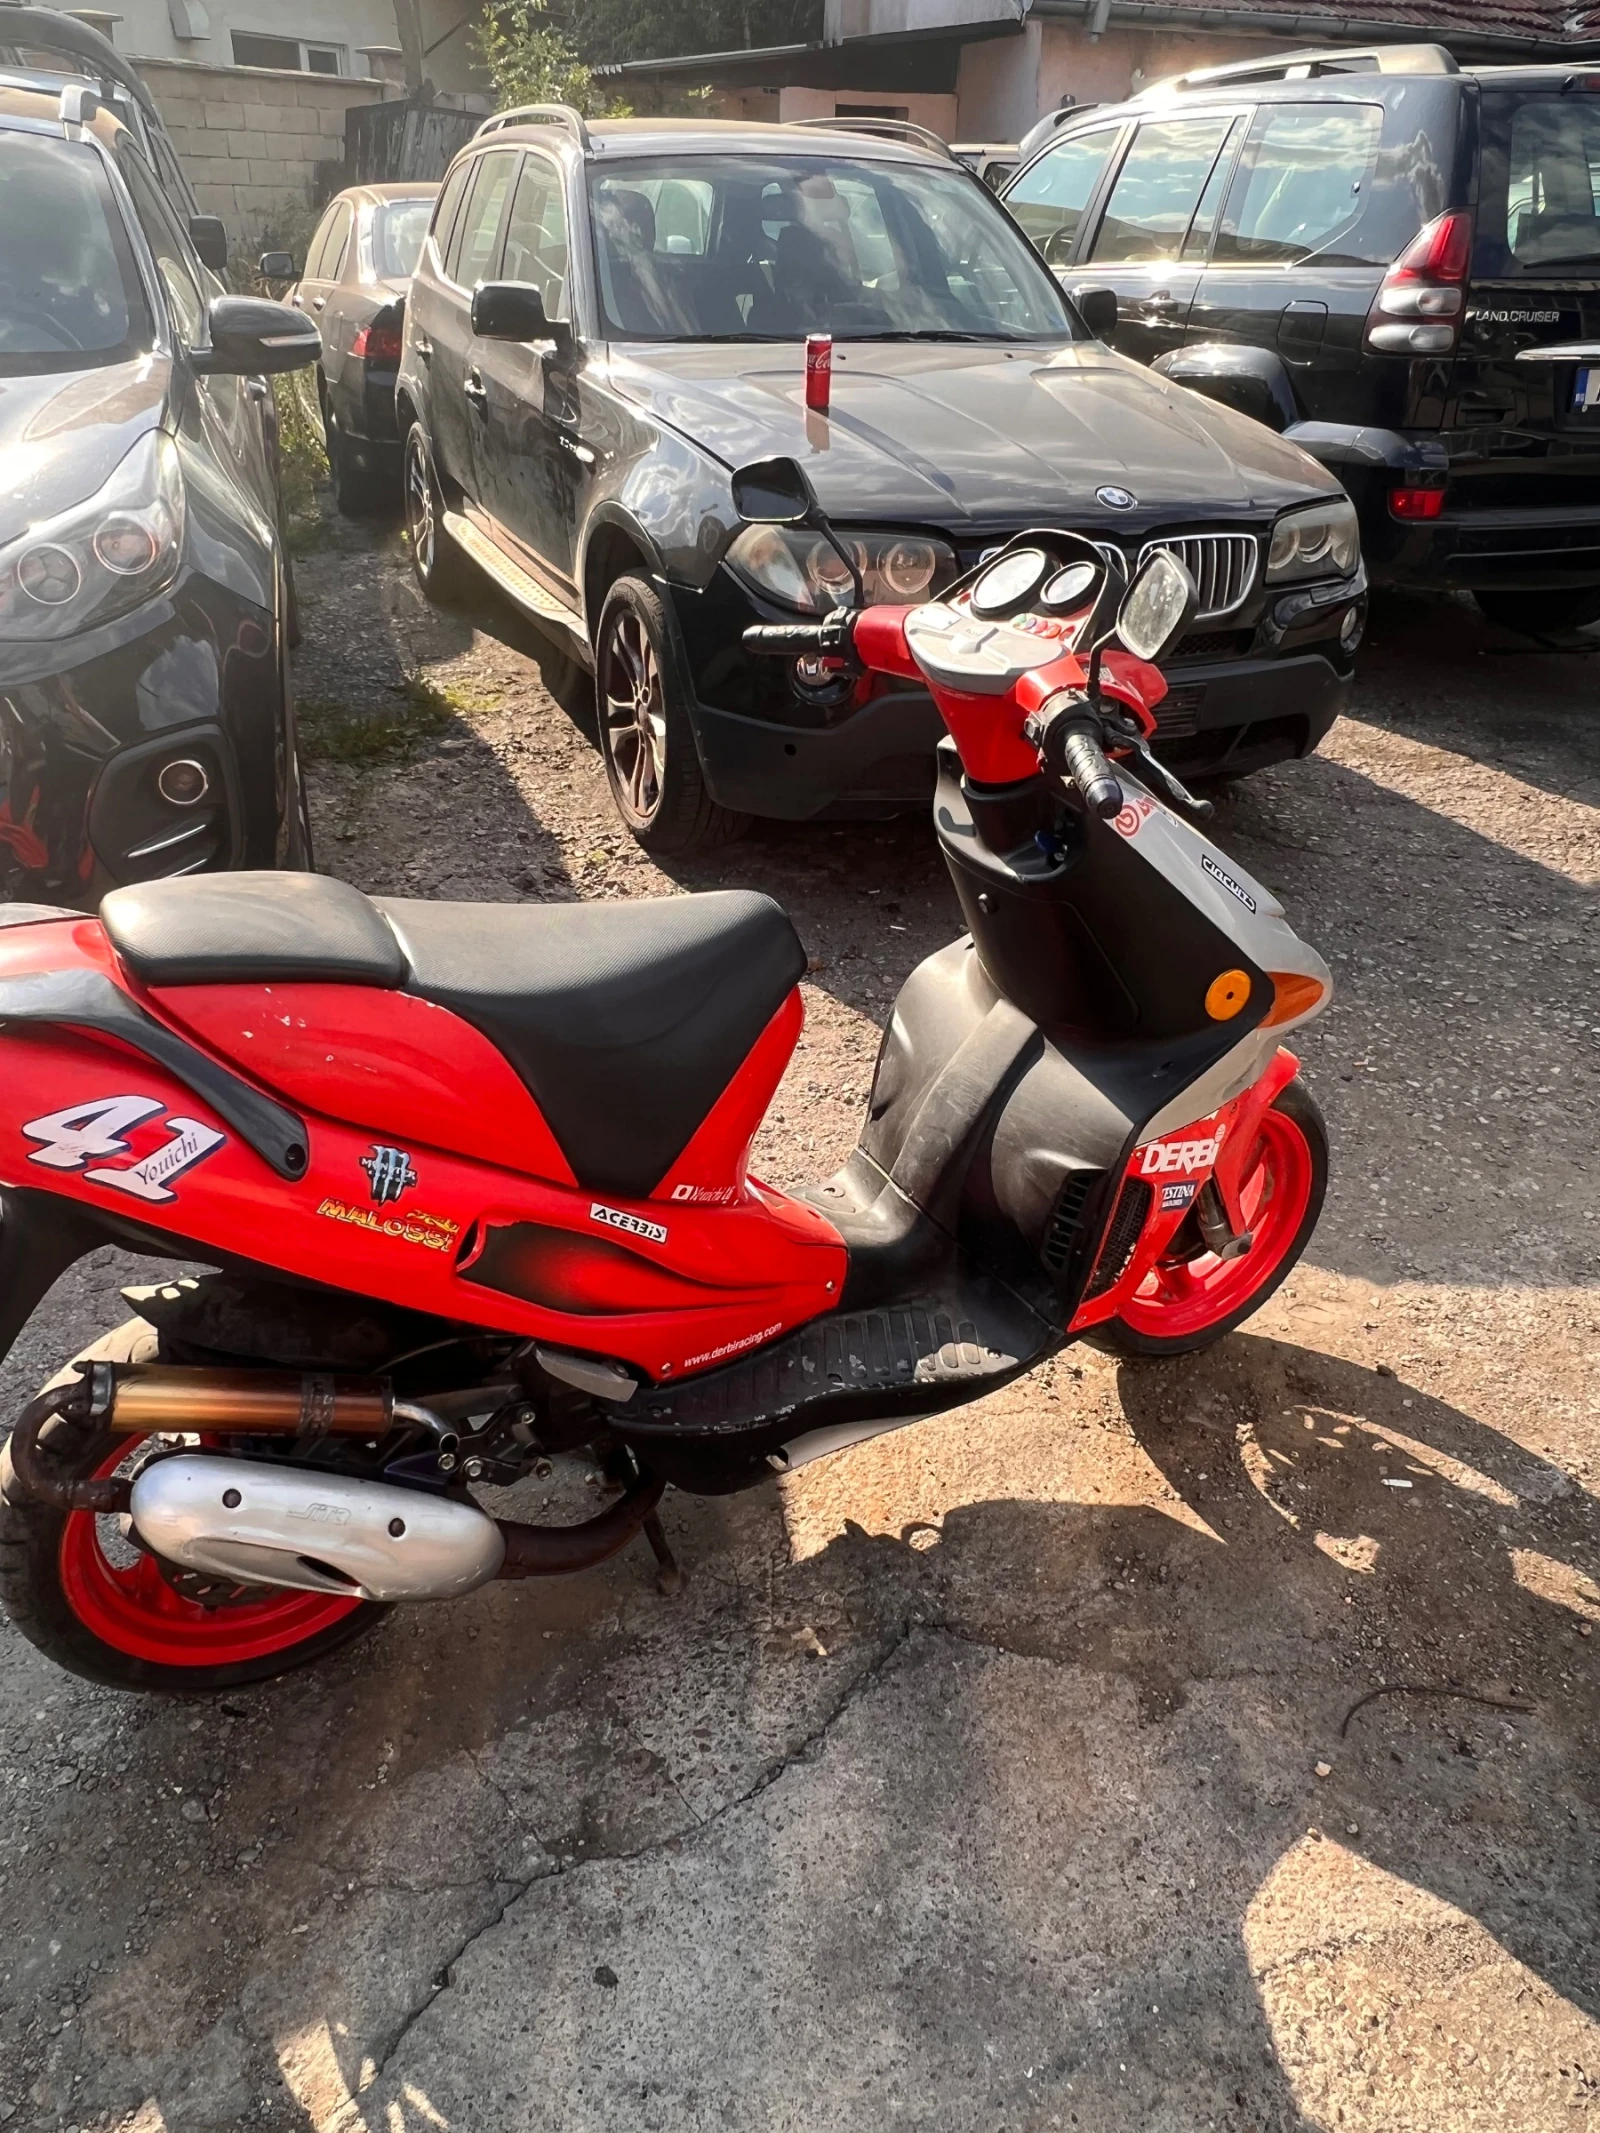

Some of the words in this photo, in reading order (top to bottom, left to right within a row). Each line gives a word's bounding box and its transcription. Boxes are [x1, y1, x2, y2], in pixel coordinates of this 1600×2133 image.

[1475, 310, 1509, 322] LAND
[1510, 310, 1560, 323] CRUISER
[22, 1095, 228, 1205] 41
[134, 1131, 200, 1186] Youichi
[361, 1157, 417, 1181] MNTR
[683, 1322, 783, 1368] www.derbiracing.com
